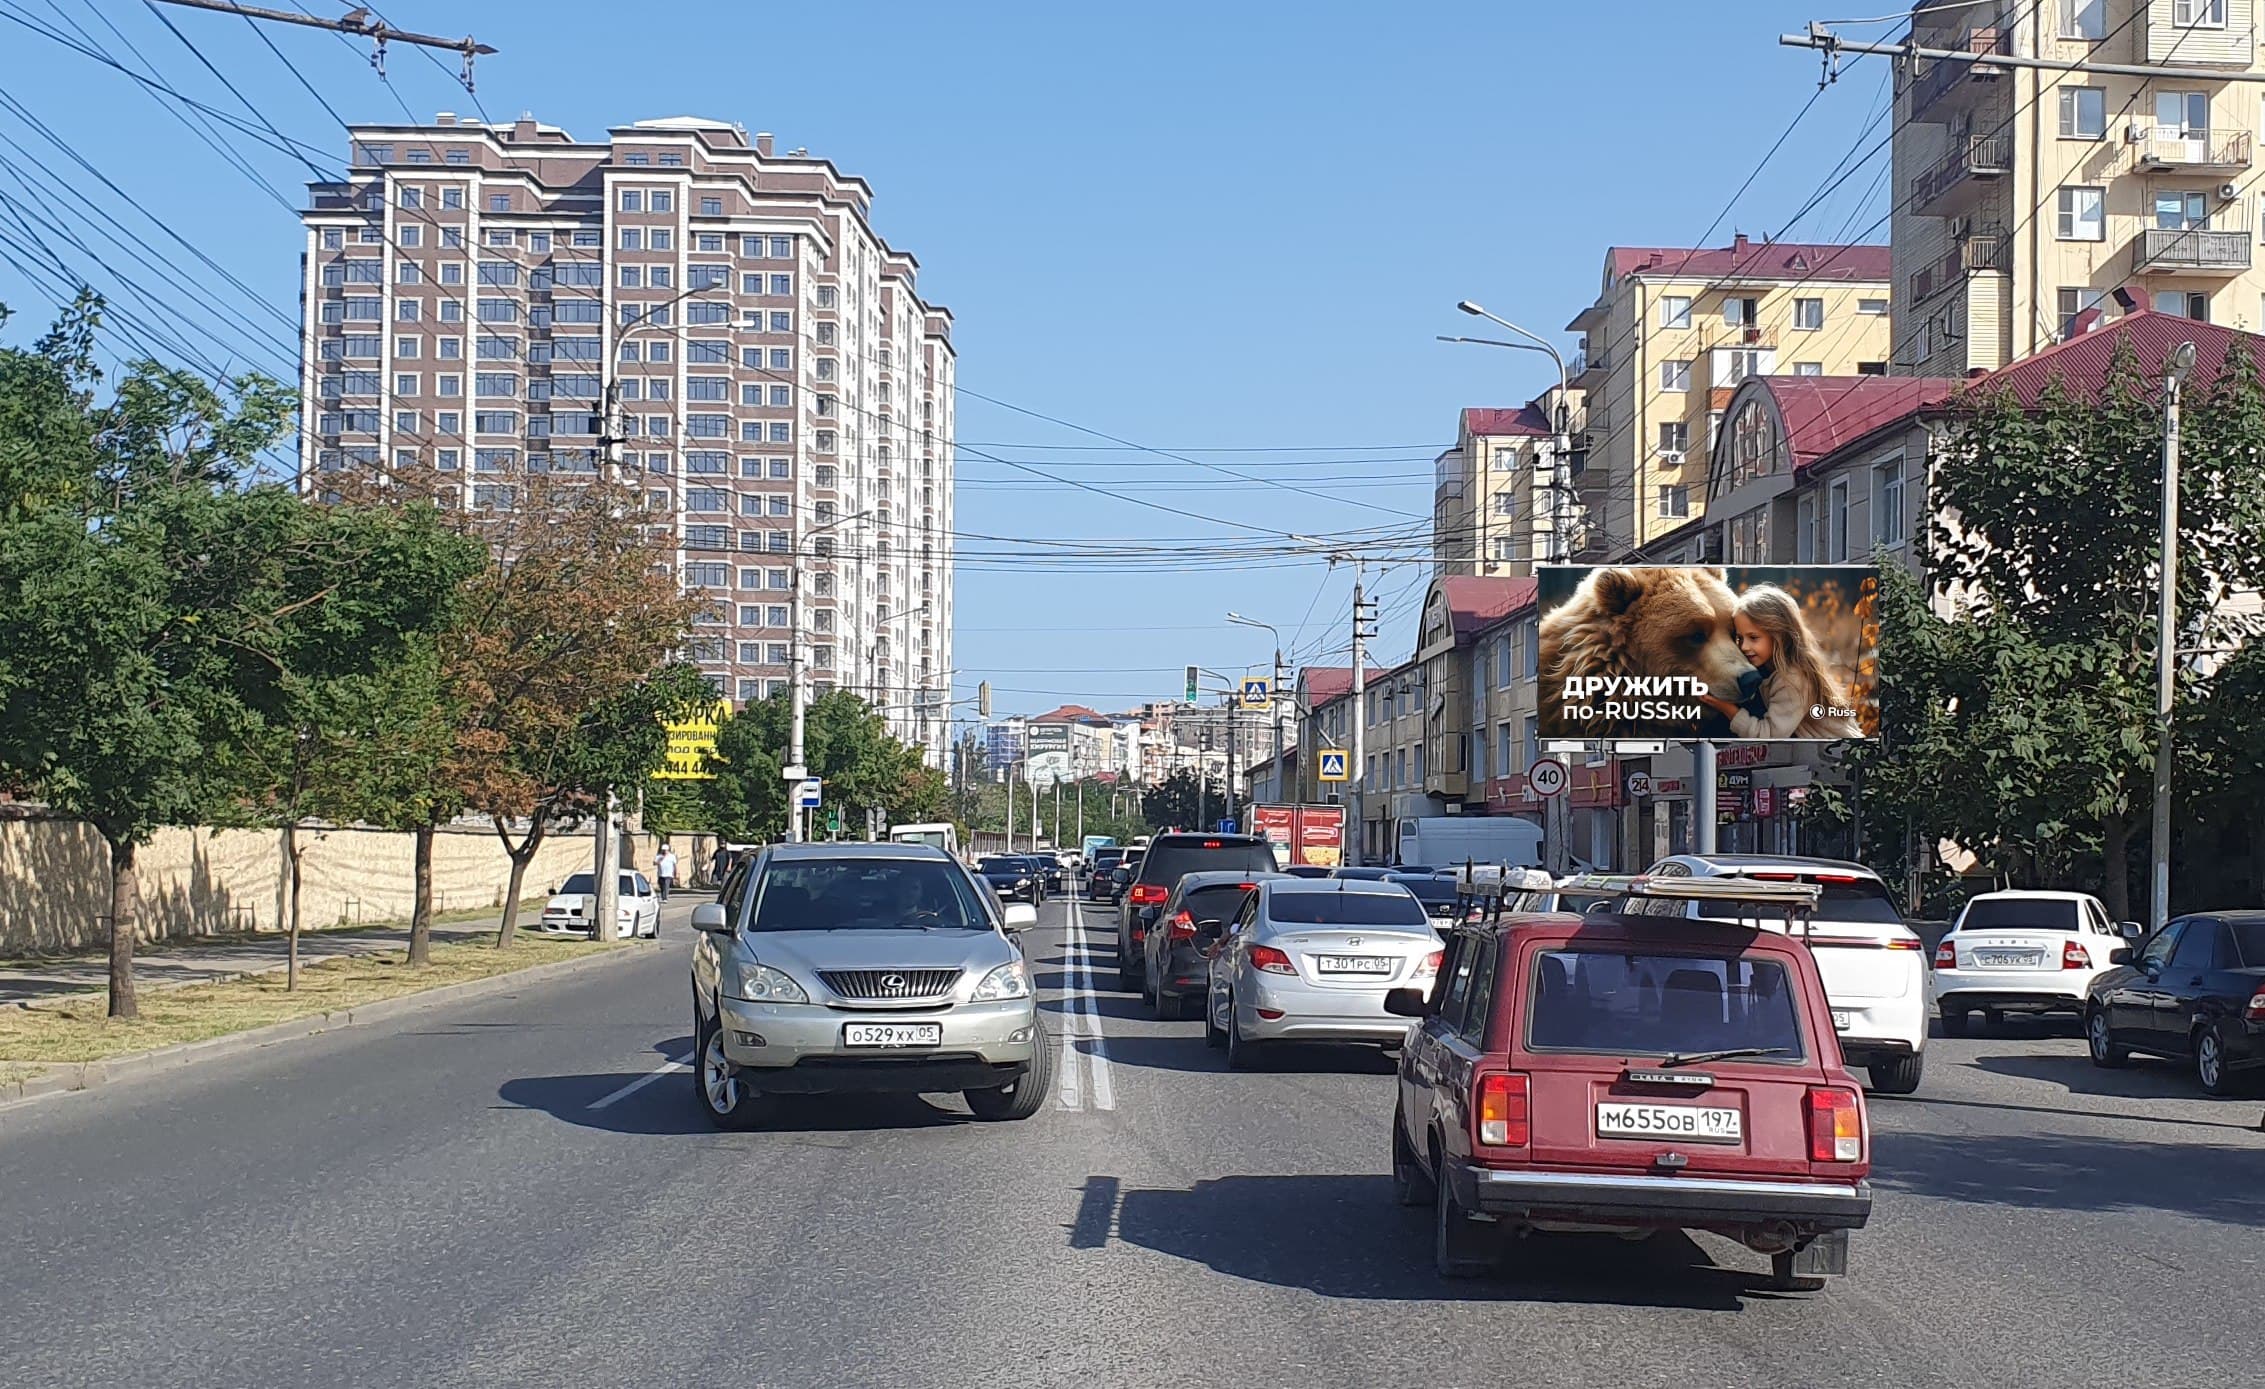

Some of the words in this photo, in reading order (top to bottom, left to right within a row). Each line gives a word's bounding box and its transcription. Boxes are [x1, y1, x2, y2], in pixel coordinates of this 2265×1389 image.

[1562, 676, 1709, 699] ДРУЖИТЬ
[1563, 701, 1701, 720] по-RUSSки
[1828, 707, 1857, 717] Russ
[1537, 770, 1559, 785] 40
[853, 1027, 914, 1042] О529ХХ
[1606, 1108, 1695, 1131] М655ОВ
[1701, 1110, 1733, 1128] 197
